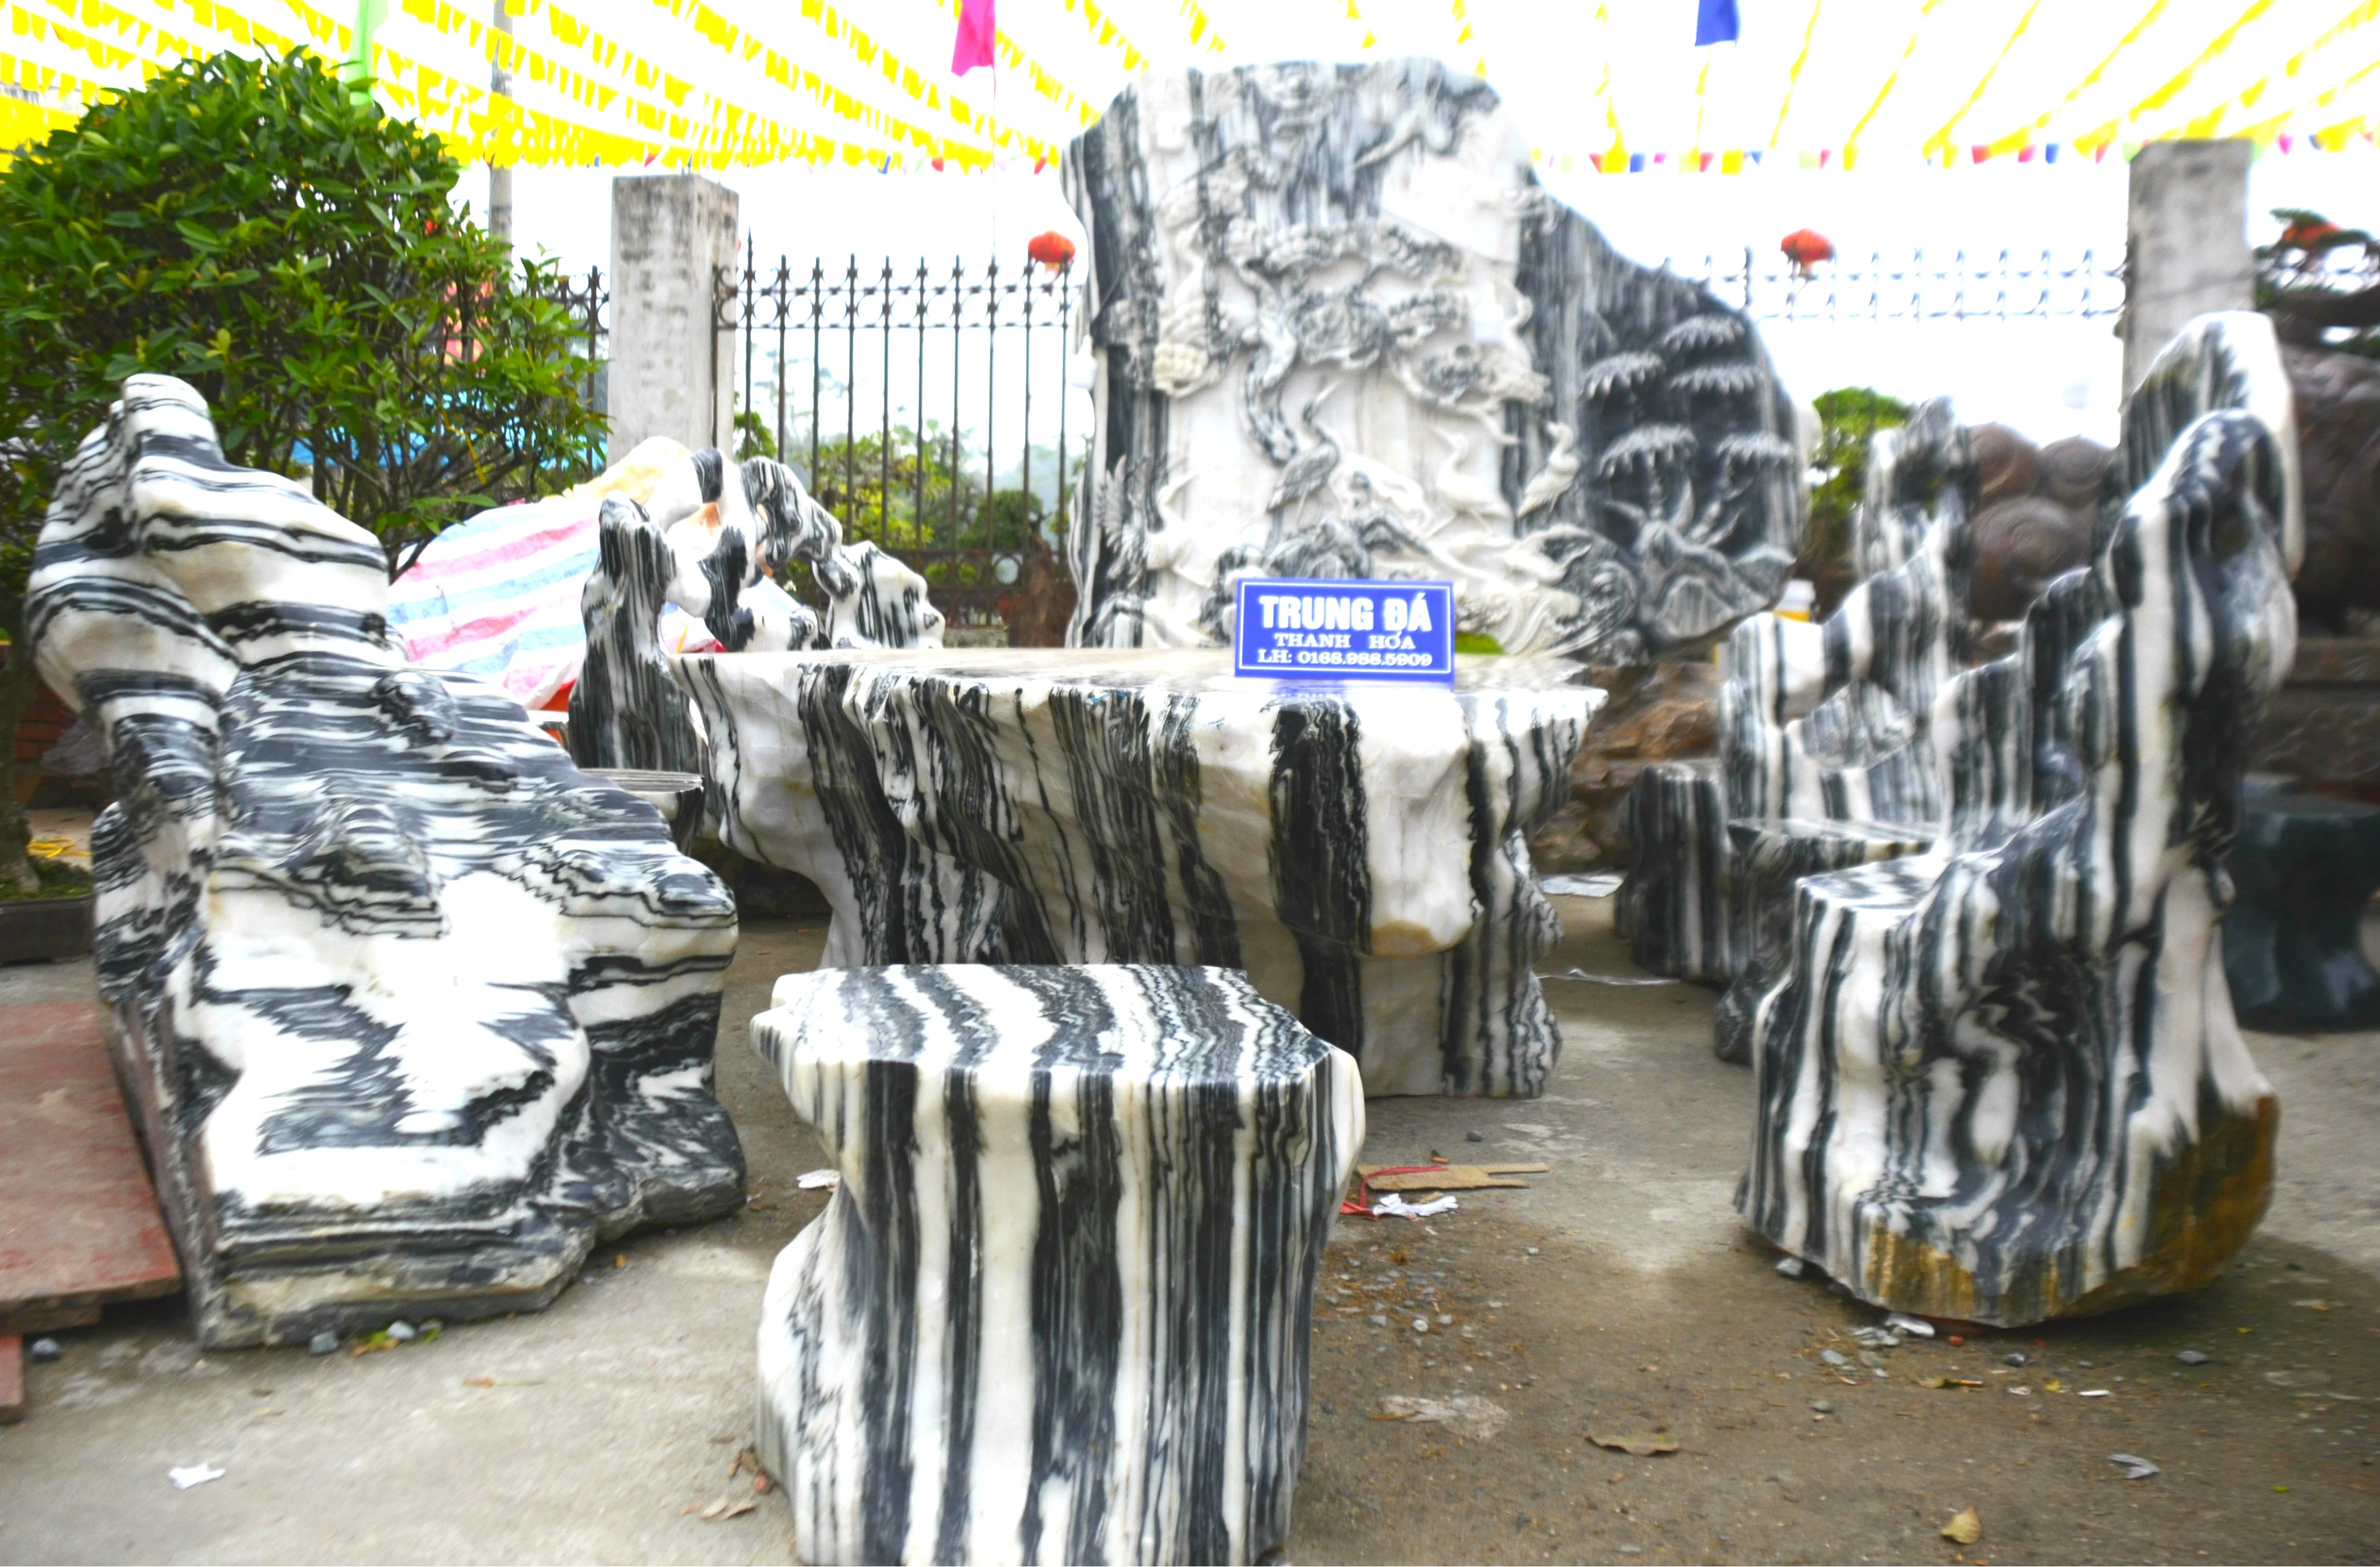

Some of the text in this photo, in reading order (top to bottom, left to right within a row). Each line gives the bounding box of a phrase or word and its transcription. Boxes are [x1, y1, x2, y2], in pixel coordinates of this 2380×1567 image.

[1259, 592, 1432, 631] TRUNG ĐÁ
[1275, 630, 1415, 649] THANH HÓA
[1258, 649, 1433, 666] LH: 0168.988.5909
